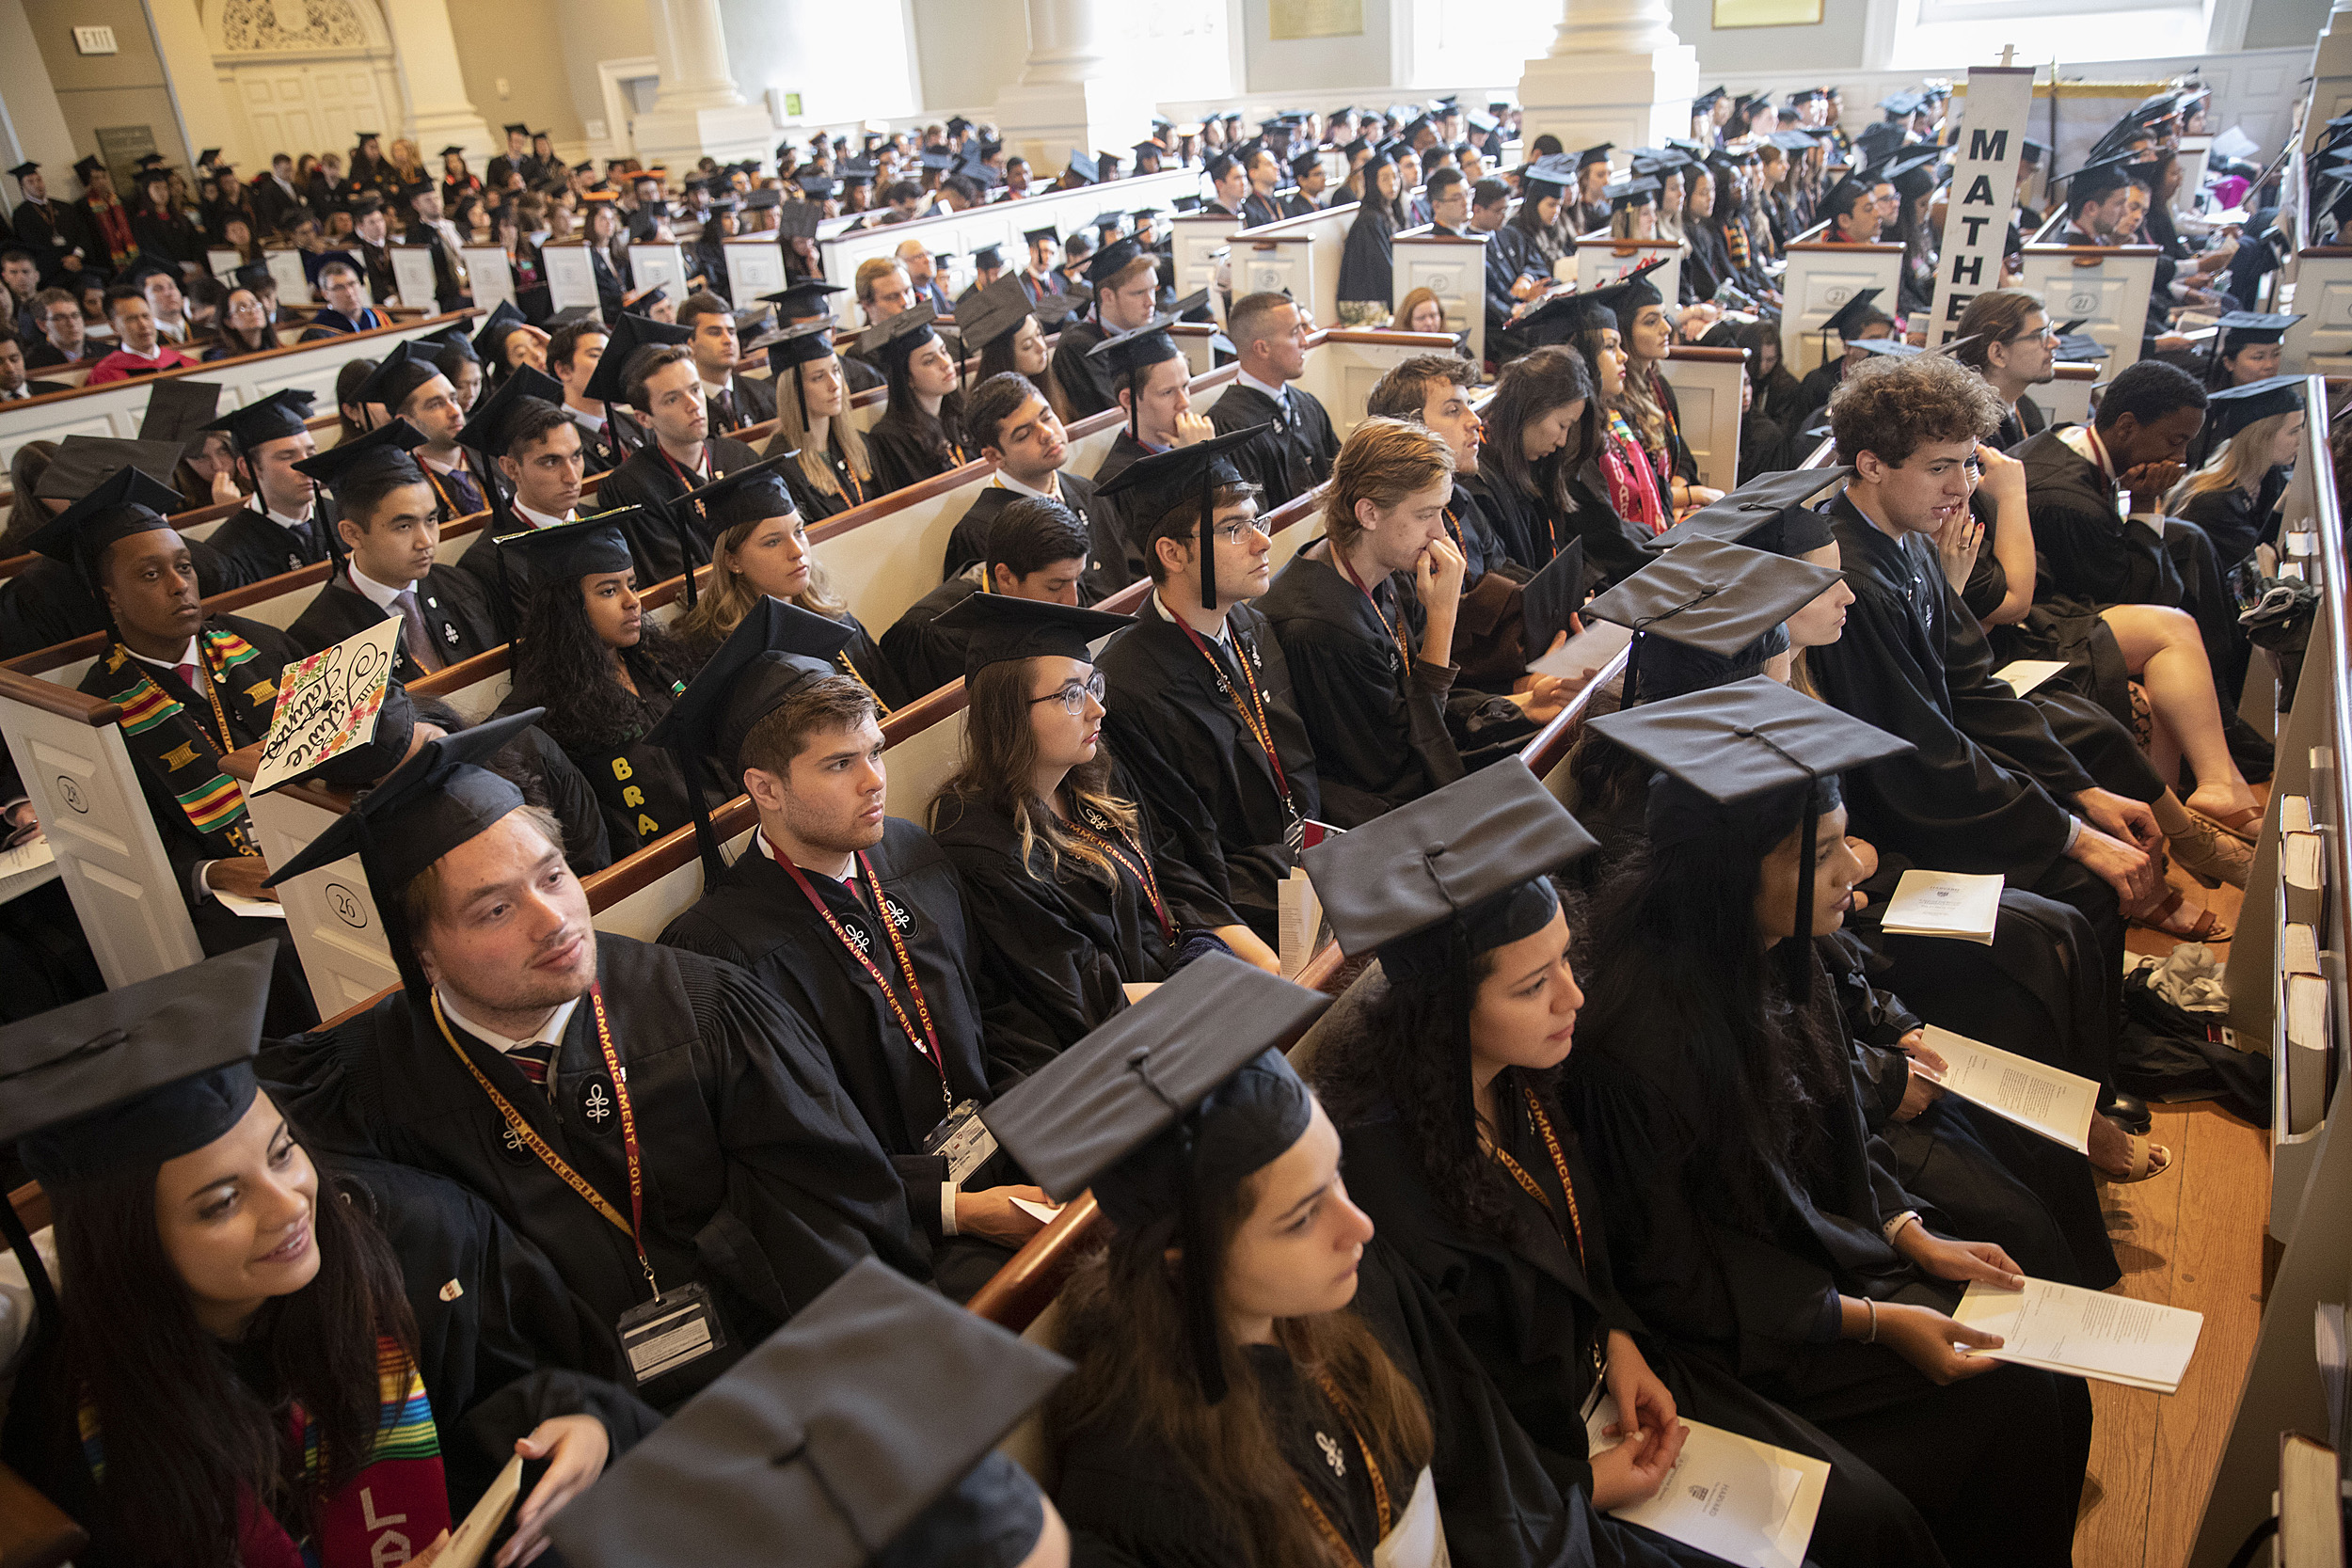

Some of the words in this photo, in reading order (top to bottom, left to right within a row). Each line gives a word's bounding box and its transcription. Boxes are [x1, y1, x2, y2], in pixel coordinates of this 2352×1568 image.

[1942, 129, 2009, 344] MATHE
[282, 642, 388, 768] Future
[1252, 689, 1276, 753] UNIVERSITY
[63, 784, 81, 805] 28
[335, 894, 356, 918] 26
[867, 870, 919, 990] COMMENCEMENT
[915, 998, 932, 1031] 2019
[822, 909, 869, 965] HARVARD
[871, 969, 917, 1043] UNIVERSITY
[594, 994, 637, 1146] COMMENCEMENT
[628, 1155, 642, 1196] 2019
[1524, 1087, 1581, 1236] COMMENCEMENT
